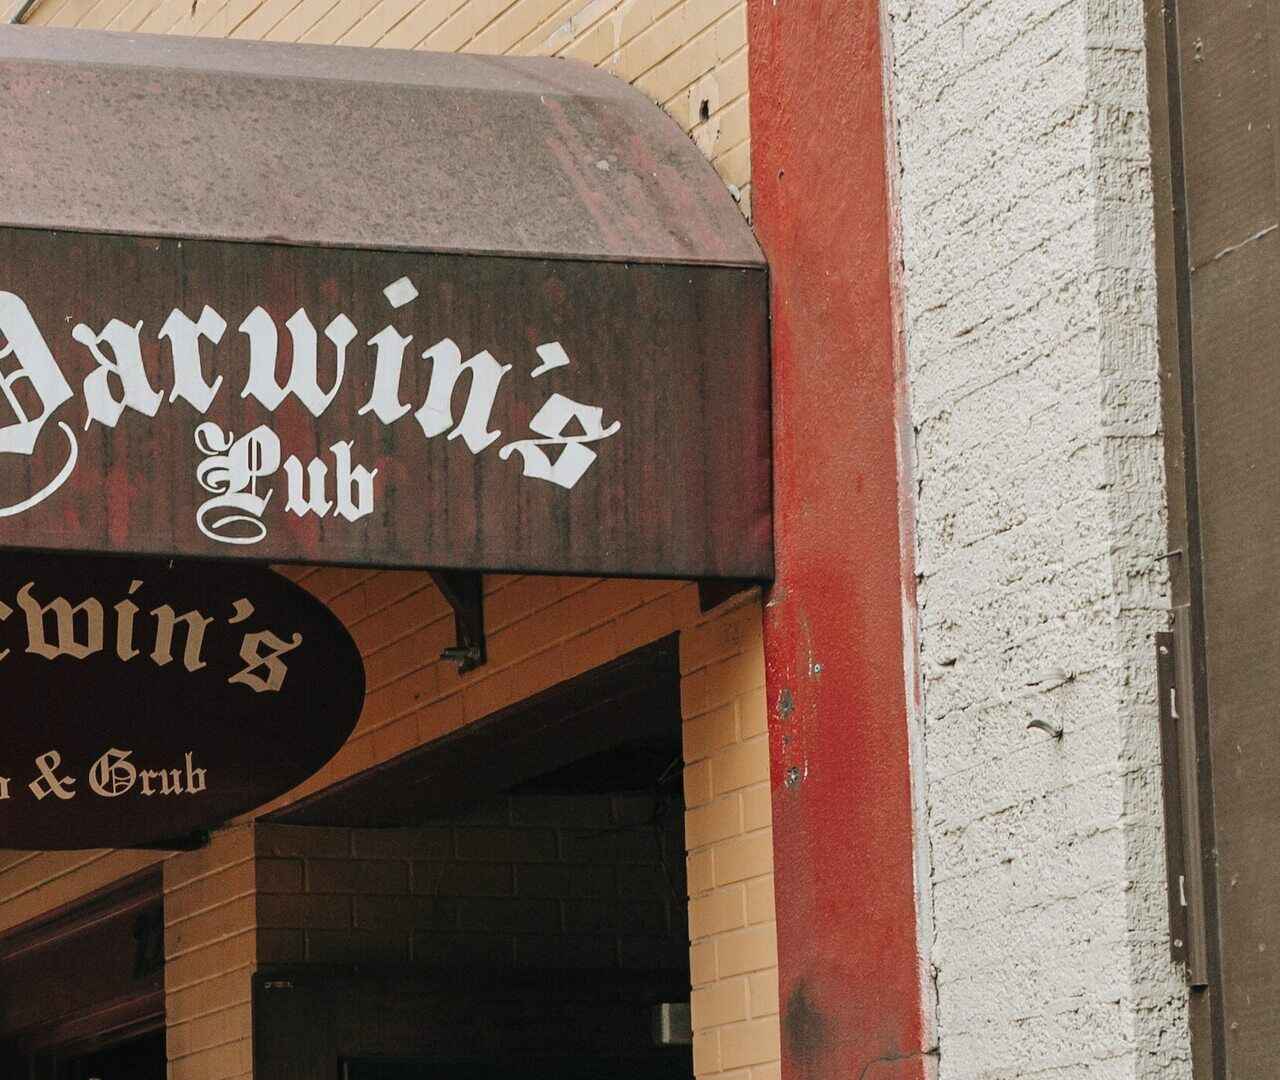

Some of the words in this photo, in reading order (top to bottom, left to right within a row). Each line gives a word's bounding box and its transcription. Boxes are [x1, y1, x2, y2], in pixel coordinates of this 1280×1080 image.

[196, 421, 378, 544] Pub
[28, 749, 76, 800] &
[88, 748, 207, 798] Grub
